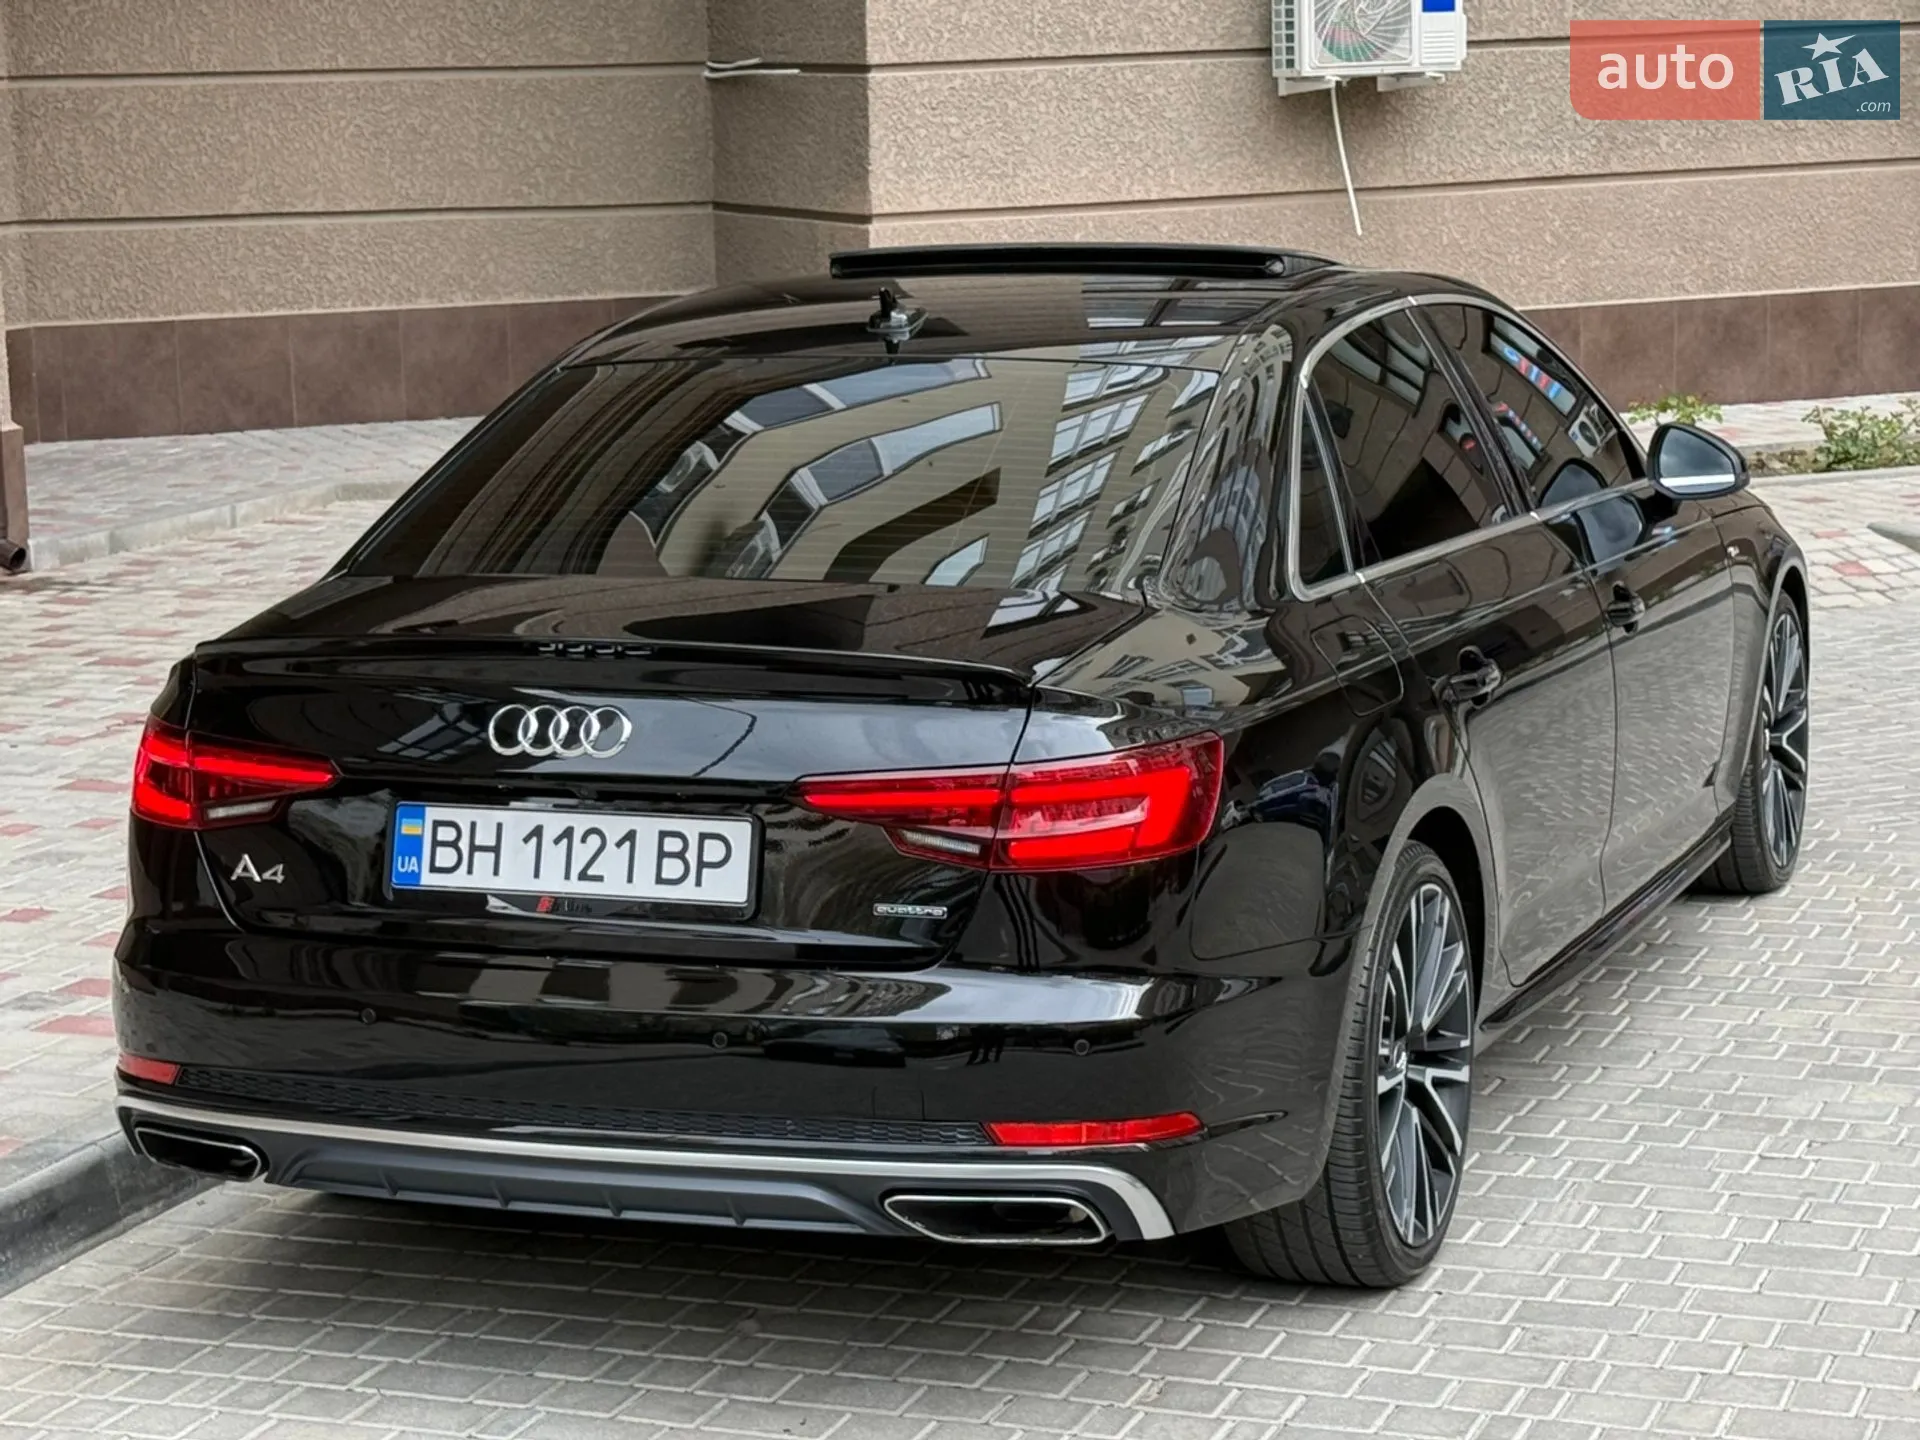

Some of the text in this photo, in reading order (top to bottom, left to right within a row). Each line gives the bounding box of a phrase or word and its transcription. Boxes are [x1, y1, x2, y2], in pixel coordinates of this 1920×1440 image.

[230, 853, 285, 883] A4
[397, 855, 419, 873] UA
[429, 819, 732, 887] BH 1121 BP
